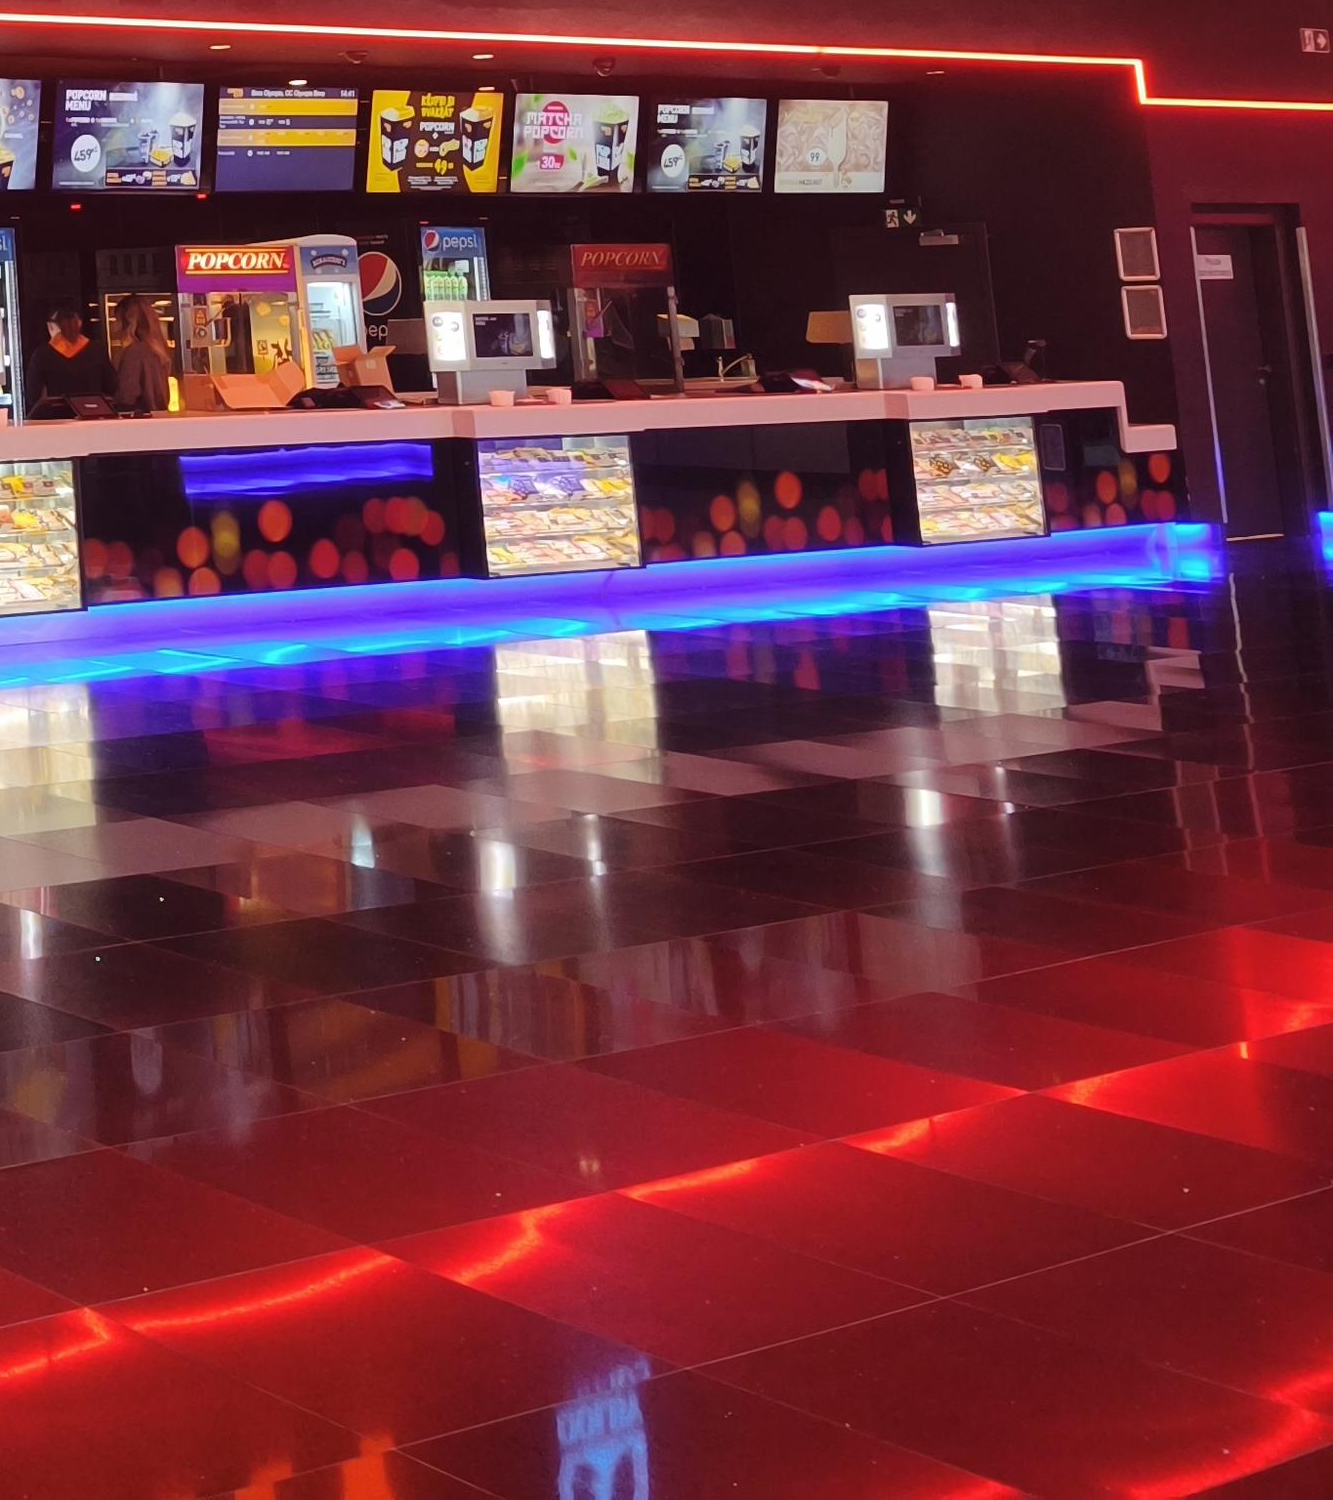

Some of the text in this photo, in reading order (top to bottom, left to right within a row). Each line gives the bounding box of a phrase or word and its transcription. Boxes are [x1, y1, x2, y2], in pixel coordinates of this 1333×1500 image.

[65, 90, 107, 101] POPCORN
[65, 100, 92, 111] MENU
[526, 112, 582, 125] MATCHA
[523, 125, 583, 139] POPCORN
[541, 156, 555, 169] 30
[442, 236, 477, 250] pepsi
[187, 252, 283, 271] POPCORN
[580, 250, 663, 267] POPCORN
